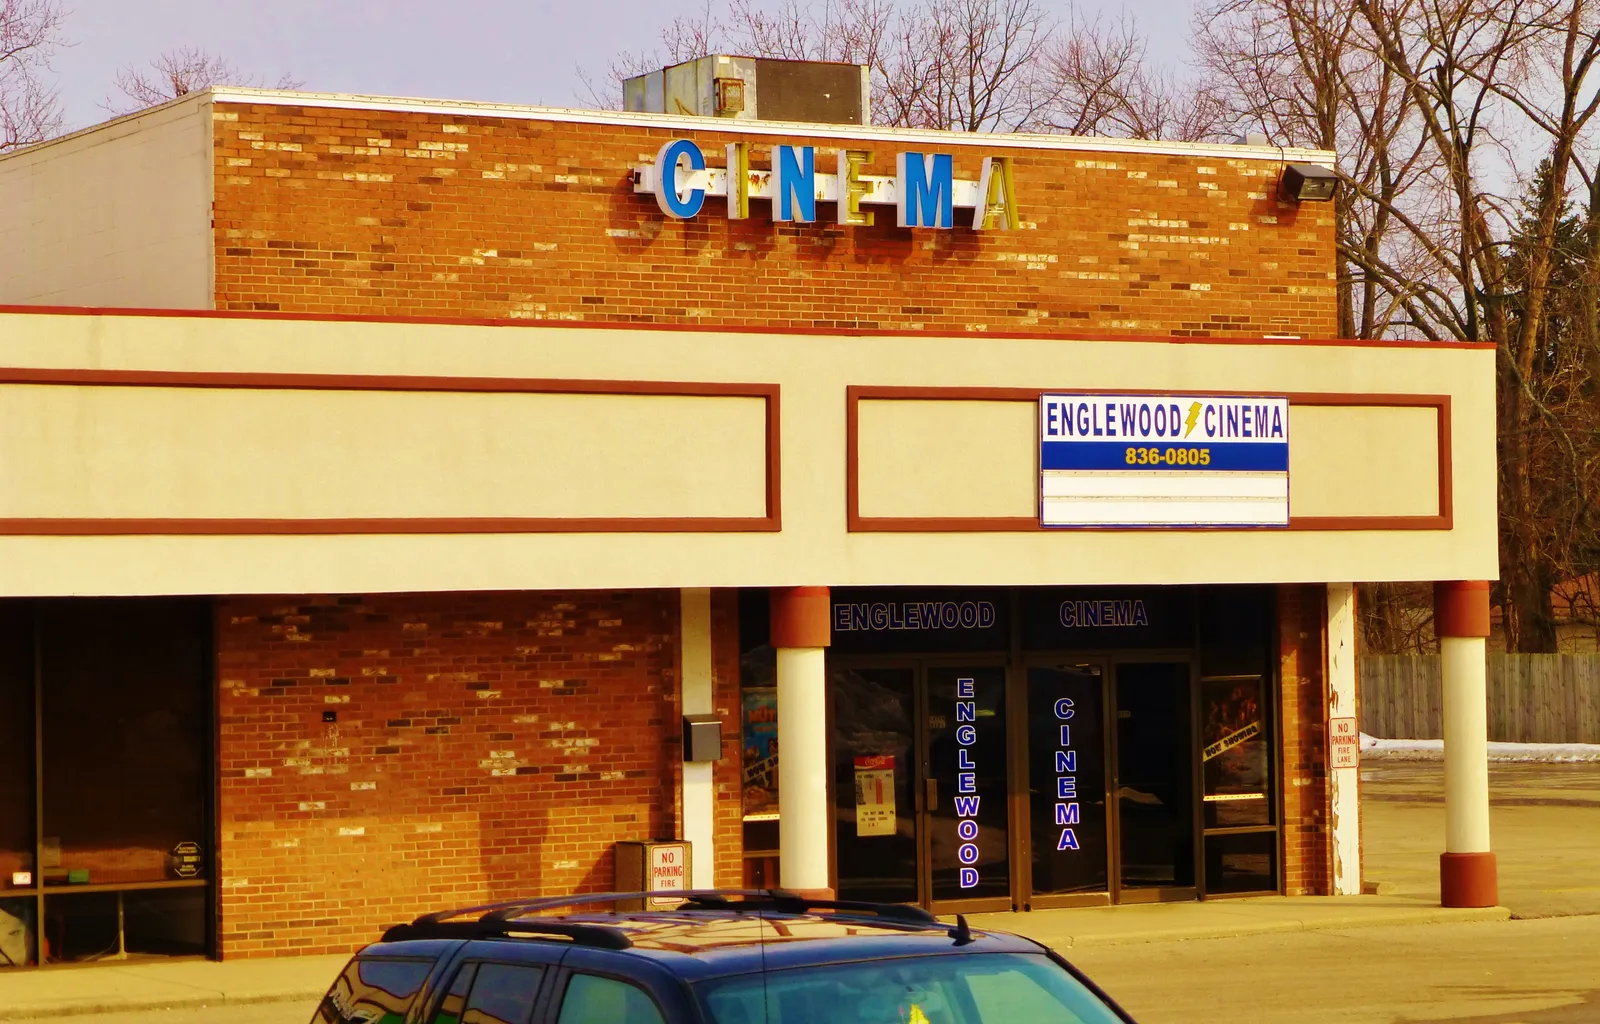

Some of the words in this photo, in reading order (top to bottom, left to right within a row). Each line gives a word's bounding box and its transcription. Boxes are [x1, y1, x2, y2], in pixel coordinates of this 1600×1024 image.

[655, 139, 1019, 231] CINEMA
[1047, 402, 1182, 437] ENGLEWOOD
[1204, 404, 1284, 438] CINEMA
[1125, 447, 1211, 465] 836-0805
[834, 601, 996, 631] ENGLEWOOD
[1060, 600, 1148, 627] CINEMA
[1204, 743, 1222, 758] NOW
[1223, 725, 1257, 748] SHOWING
[1332, 735, 1355, 745] PARKING
[1338, 723, 1348, 732] NO
[954, 678, 980, 888] ENGLEWOOD
[1054, 698, 1080, 851] CINEMA
[654, 866, 682, 877] PARKING
[662, 852, 674, 863] NO
